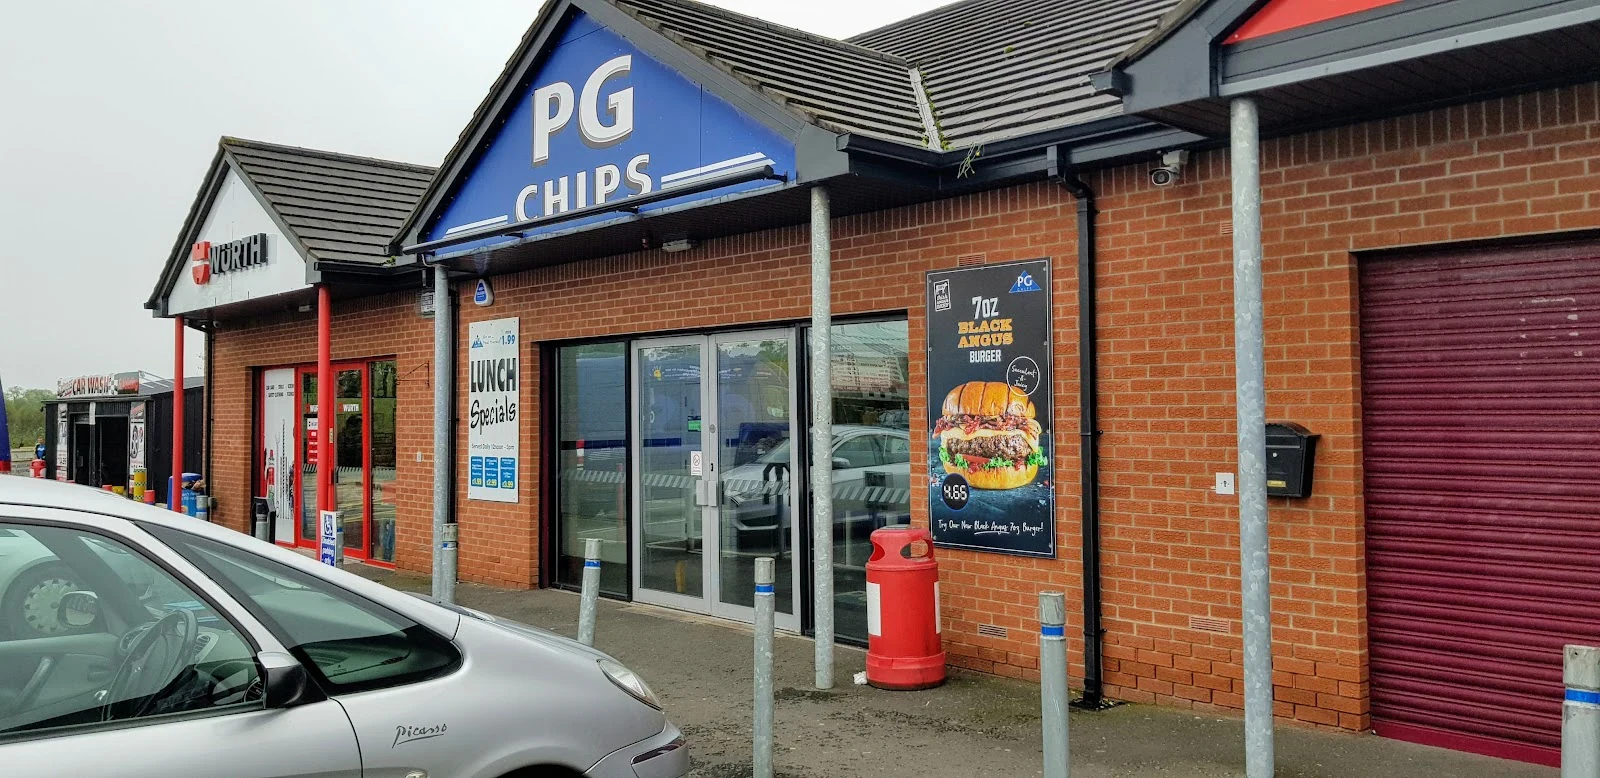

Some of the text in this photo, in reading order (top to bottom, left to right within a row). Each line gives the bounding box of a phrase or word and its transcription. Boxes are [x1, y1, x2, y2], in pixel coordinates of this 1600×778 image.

[532, 54, 634, 168] PG
[515, 153, 652, 223] CHIPS
[1017, 275, 1033, 287] PG
[958, 319, 1013, 334] BLACK
[958, 333, 1014, 348] ANGUS
[969, 349, 1002, 363] BURGER
[72, 378, 86, 396] CAR
[87, 375, 109, 394] WASH
[471, 357, 517, 393] LUNCH
[470, 395, 516, 436] Specials
[943, 484, 968, 500] 4.65
[391, 723, 448, 749] Picasso
